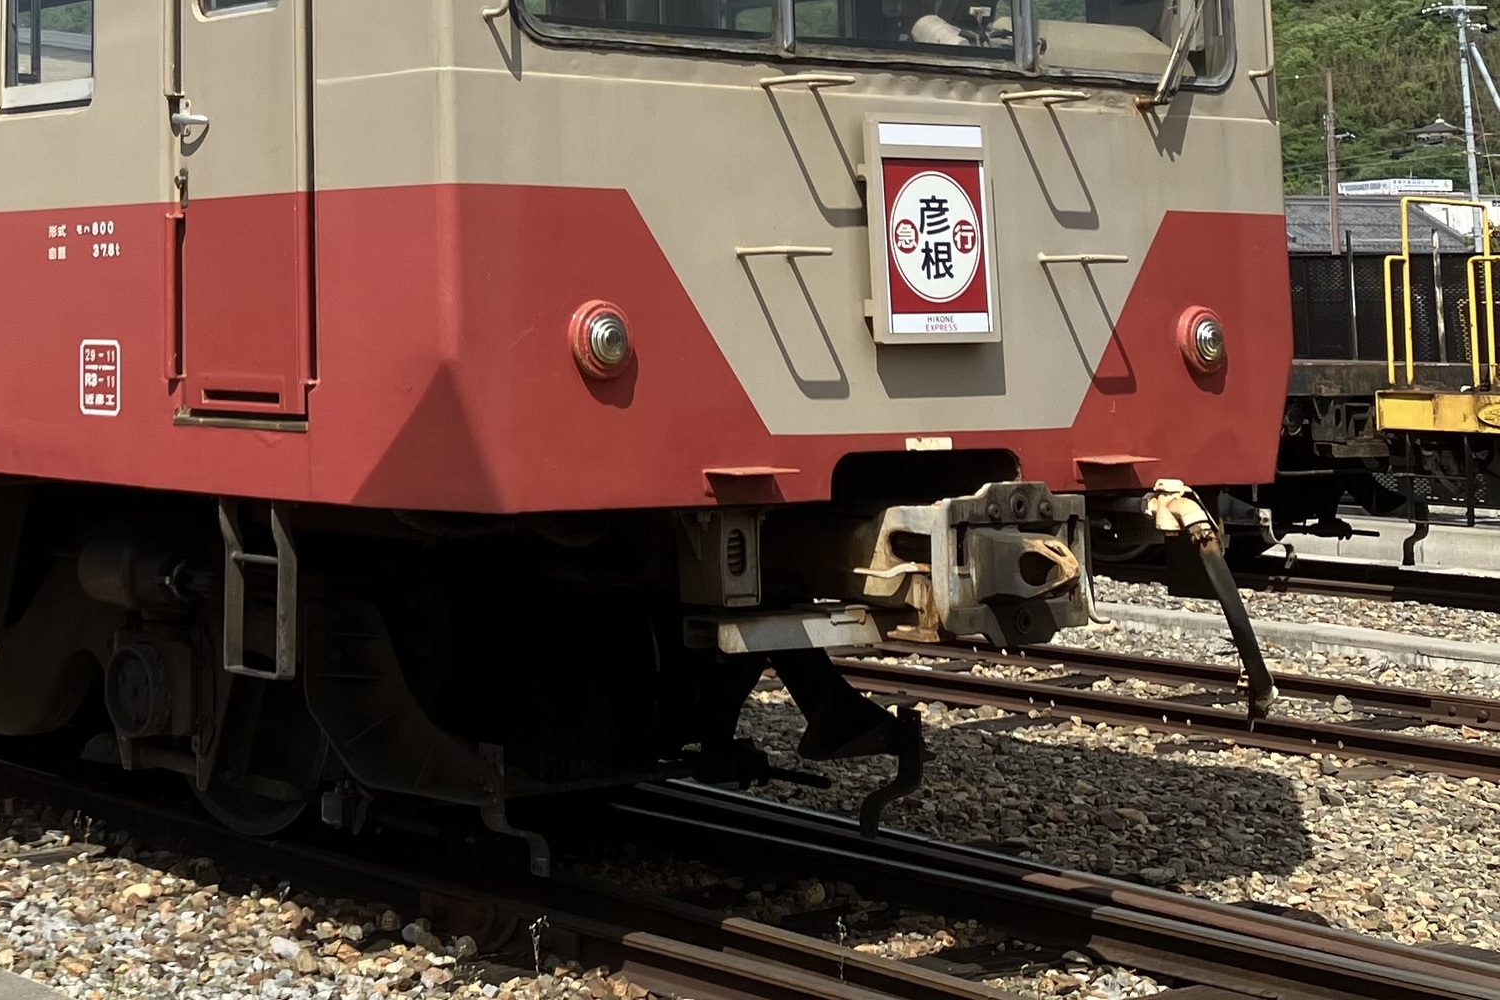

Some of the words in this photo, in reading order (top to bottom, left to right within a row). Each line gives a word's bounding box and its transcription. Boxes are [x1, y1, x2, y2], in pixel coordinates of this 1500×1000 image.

[48, 224, 67, 238] 形式
[896, 223, 918, 249] 急
[954, 225, 975, 250] 行
[918, 194, 955, 281] 彦根
[92, 242, 120, 258] 37.8t
[927, 315, 955, 323] HIKONE
[926, 324, 958, 332] EXPRESS
[84, 348, 115, 362] 29-11
